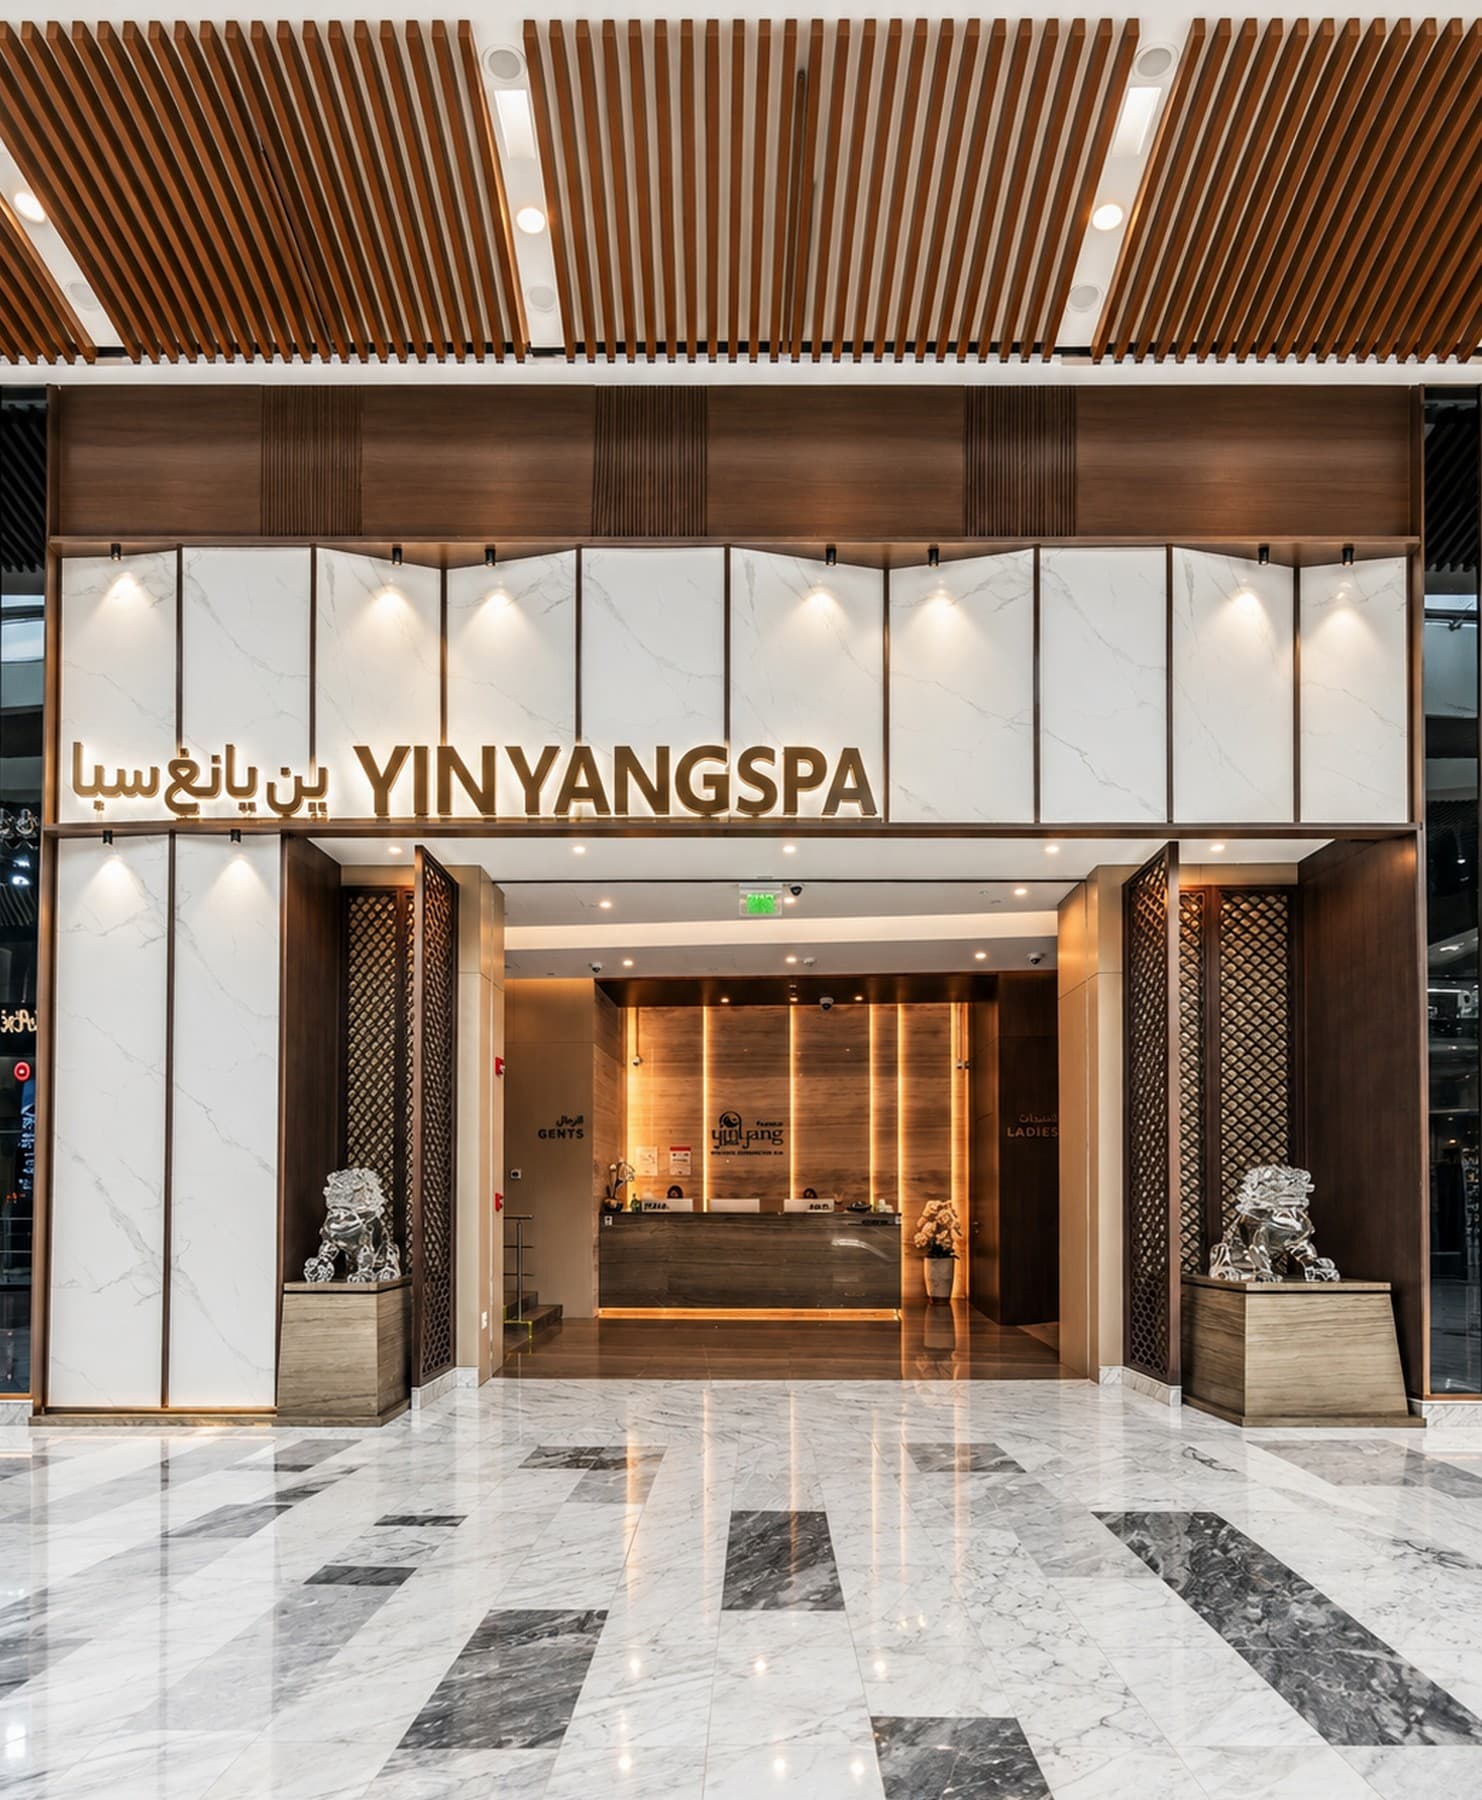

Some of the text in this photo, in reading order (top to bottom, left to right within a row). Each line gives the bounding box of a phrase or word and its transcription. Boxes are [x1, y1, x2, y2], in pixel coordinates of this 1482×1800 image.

[72, 741, 329, 816] ين يانغ سبا
[353, 745, 878, 816] YINYANGSPA
[537, 1128, 584, 1139] GENTS
[1007, 1126, 1058, 1137] LADIES
